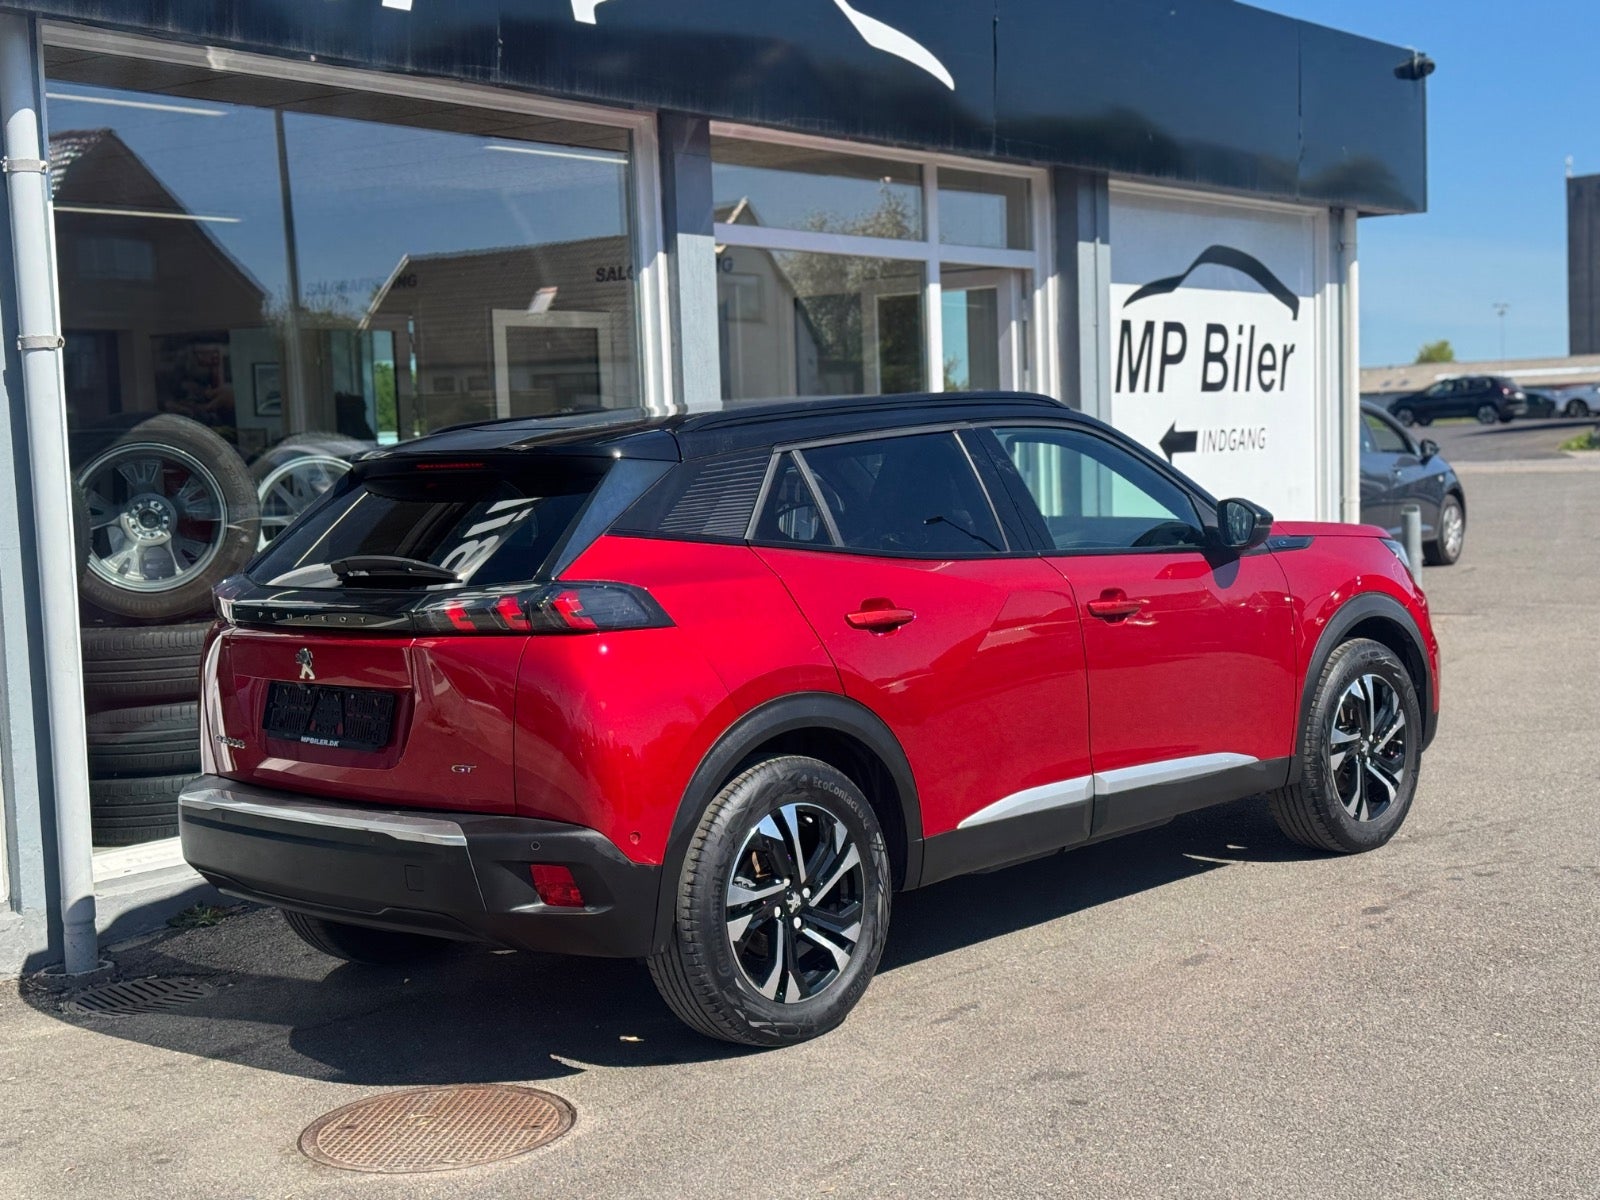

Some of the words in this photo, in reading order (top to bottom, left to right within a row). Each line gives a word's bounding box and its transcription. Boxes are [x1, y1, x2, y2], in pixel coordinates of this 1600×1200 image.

[1115, 319, 1187, 393] MP
[1200, 323, 1295, 393] Biler
[1202, 428, 1266, 453] INDGANG
[258, 611, 367, 624] PEUGEOT
[451, 764, 478, 774] GT
[812, 775, 860, 813] EcoContact
